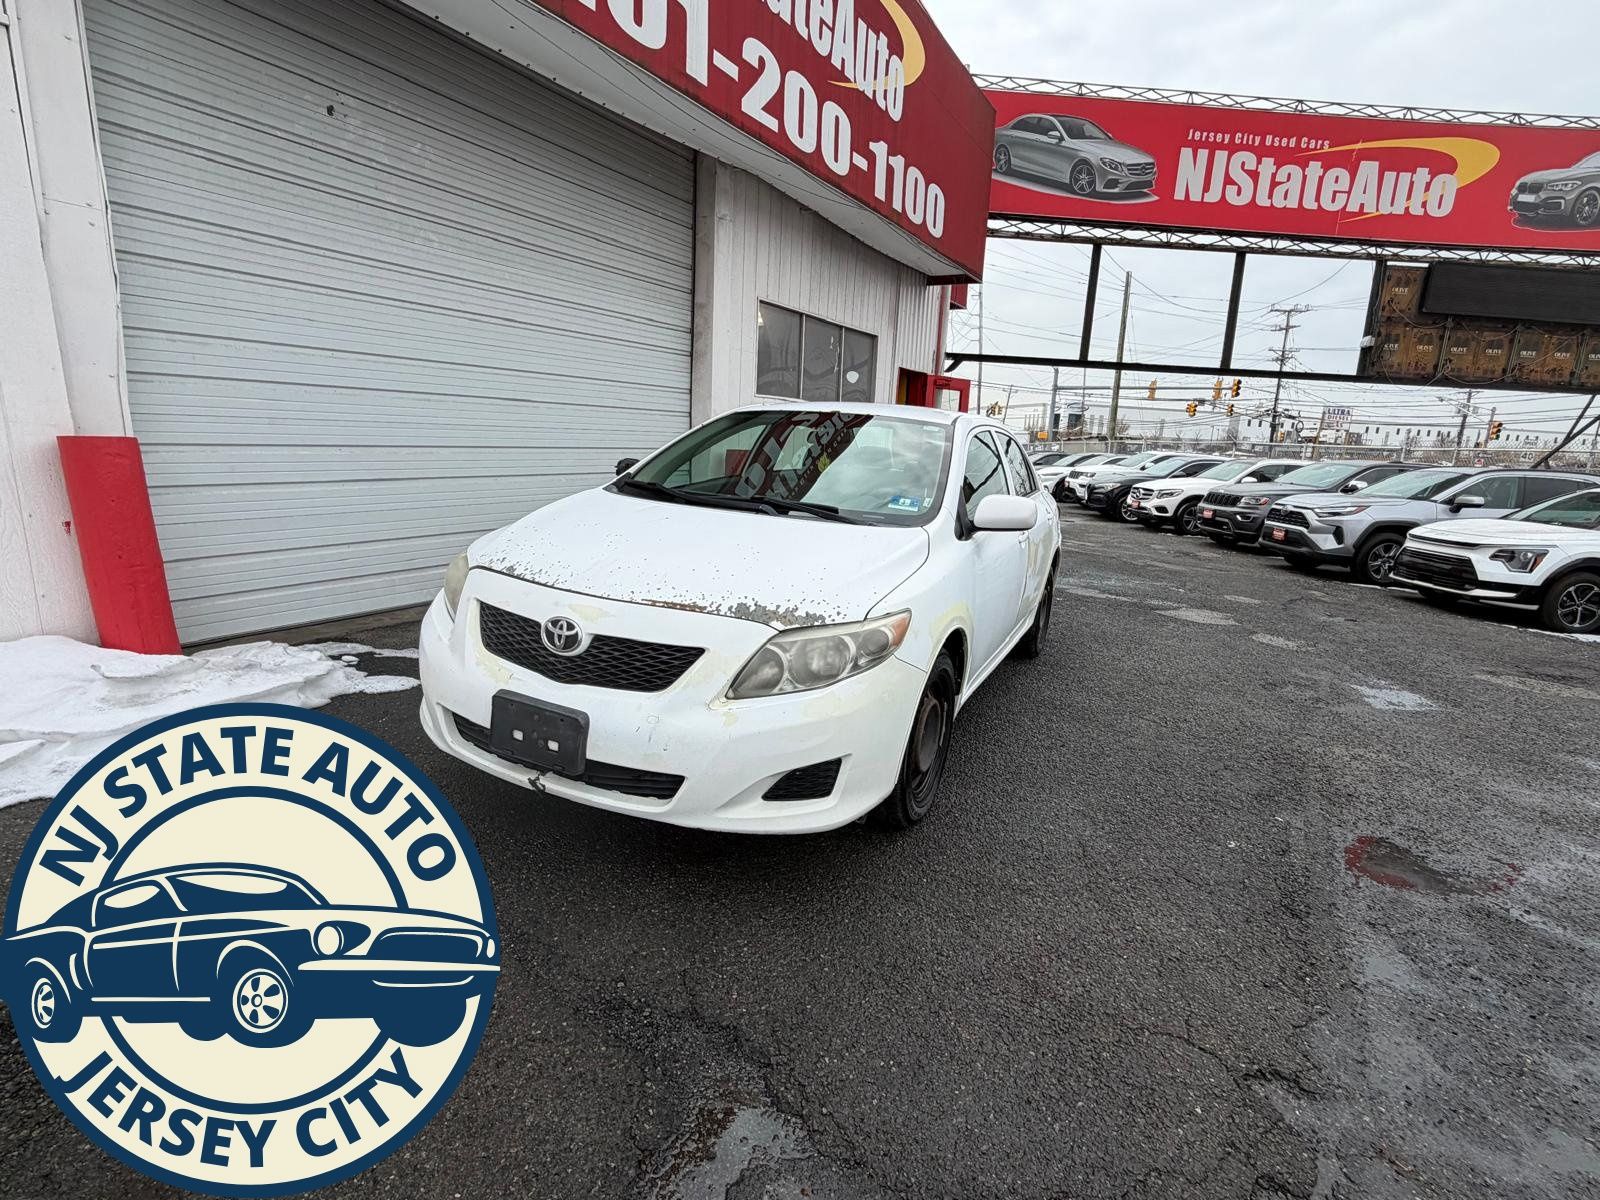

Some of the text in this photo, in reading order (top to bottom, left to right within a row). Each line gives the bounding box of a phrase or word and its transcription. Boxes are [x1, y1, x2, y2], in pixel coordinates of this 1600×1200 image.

[766, 0, 905, 122] eAuto
[577, 0, 945, 239] 1-200-1100
[1187, 129, 1330, 150] Jersey City Used Cars
[1173, 147, 1458, 218] NJStateAuto
[1520, 451, 1534, 460] 40
